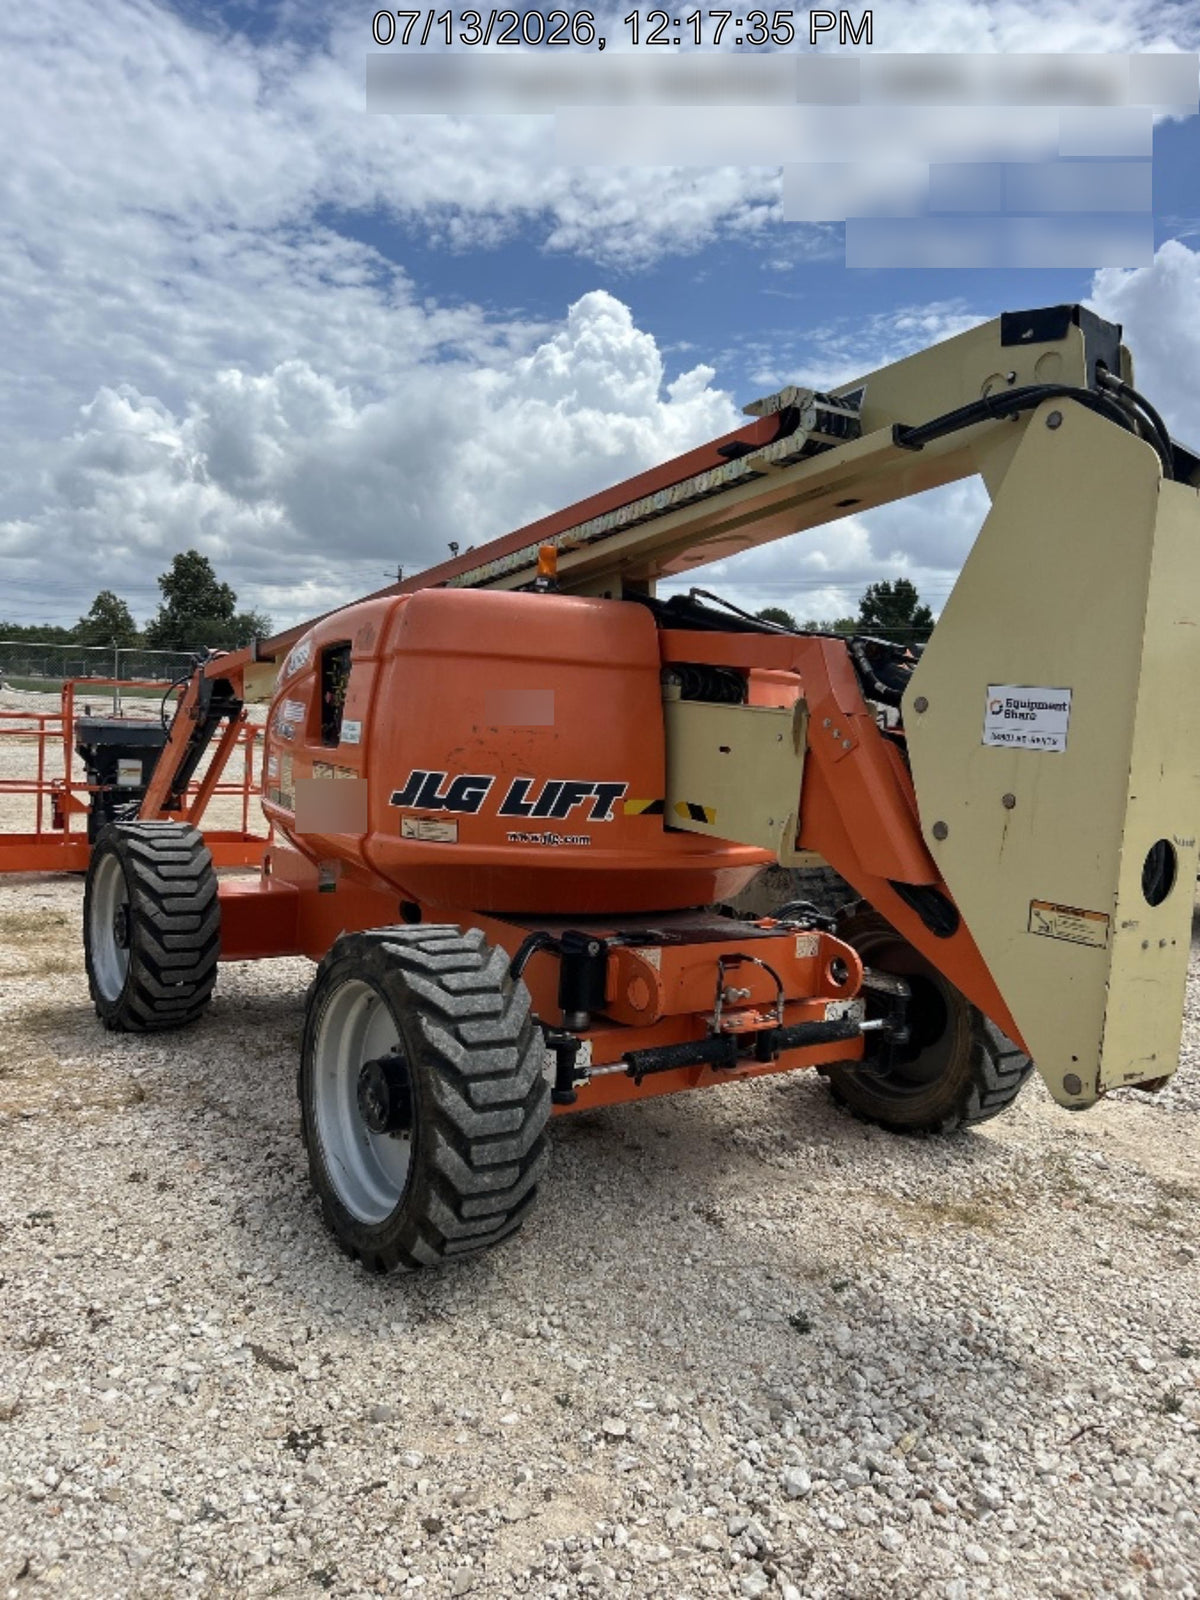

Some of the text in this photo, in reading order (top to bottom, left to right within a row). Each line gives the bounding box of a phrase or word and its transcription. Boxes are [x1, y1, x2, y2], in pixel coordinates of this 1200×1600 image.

[1005, 698, 1068, 711] Equipment
[1004, 709, 1037, 720] Share
[389, 769, 496, 814] JLG
[506, 831, 591, 846] www.jlg.com
